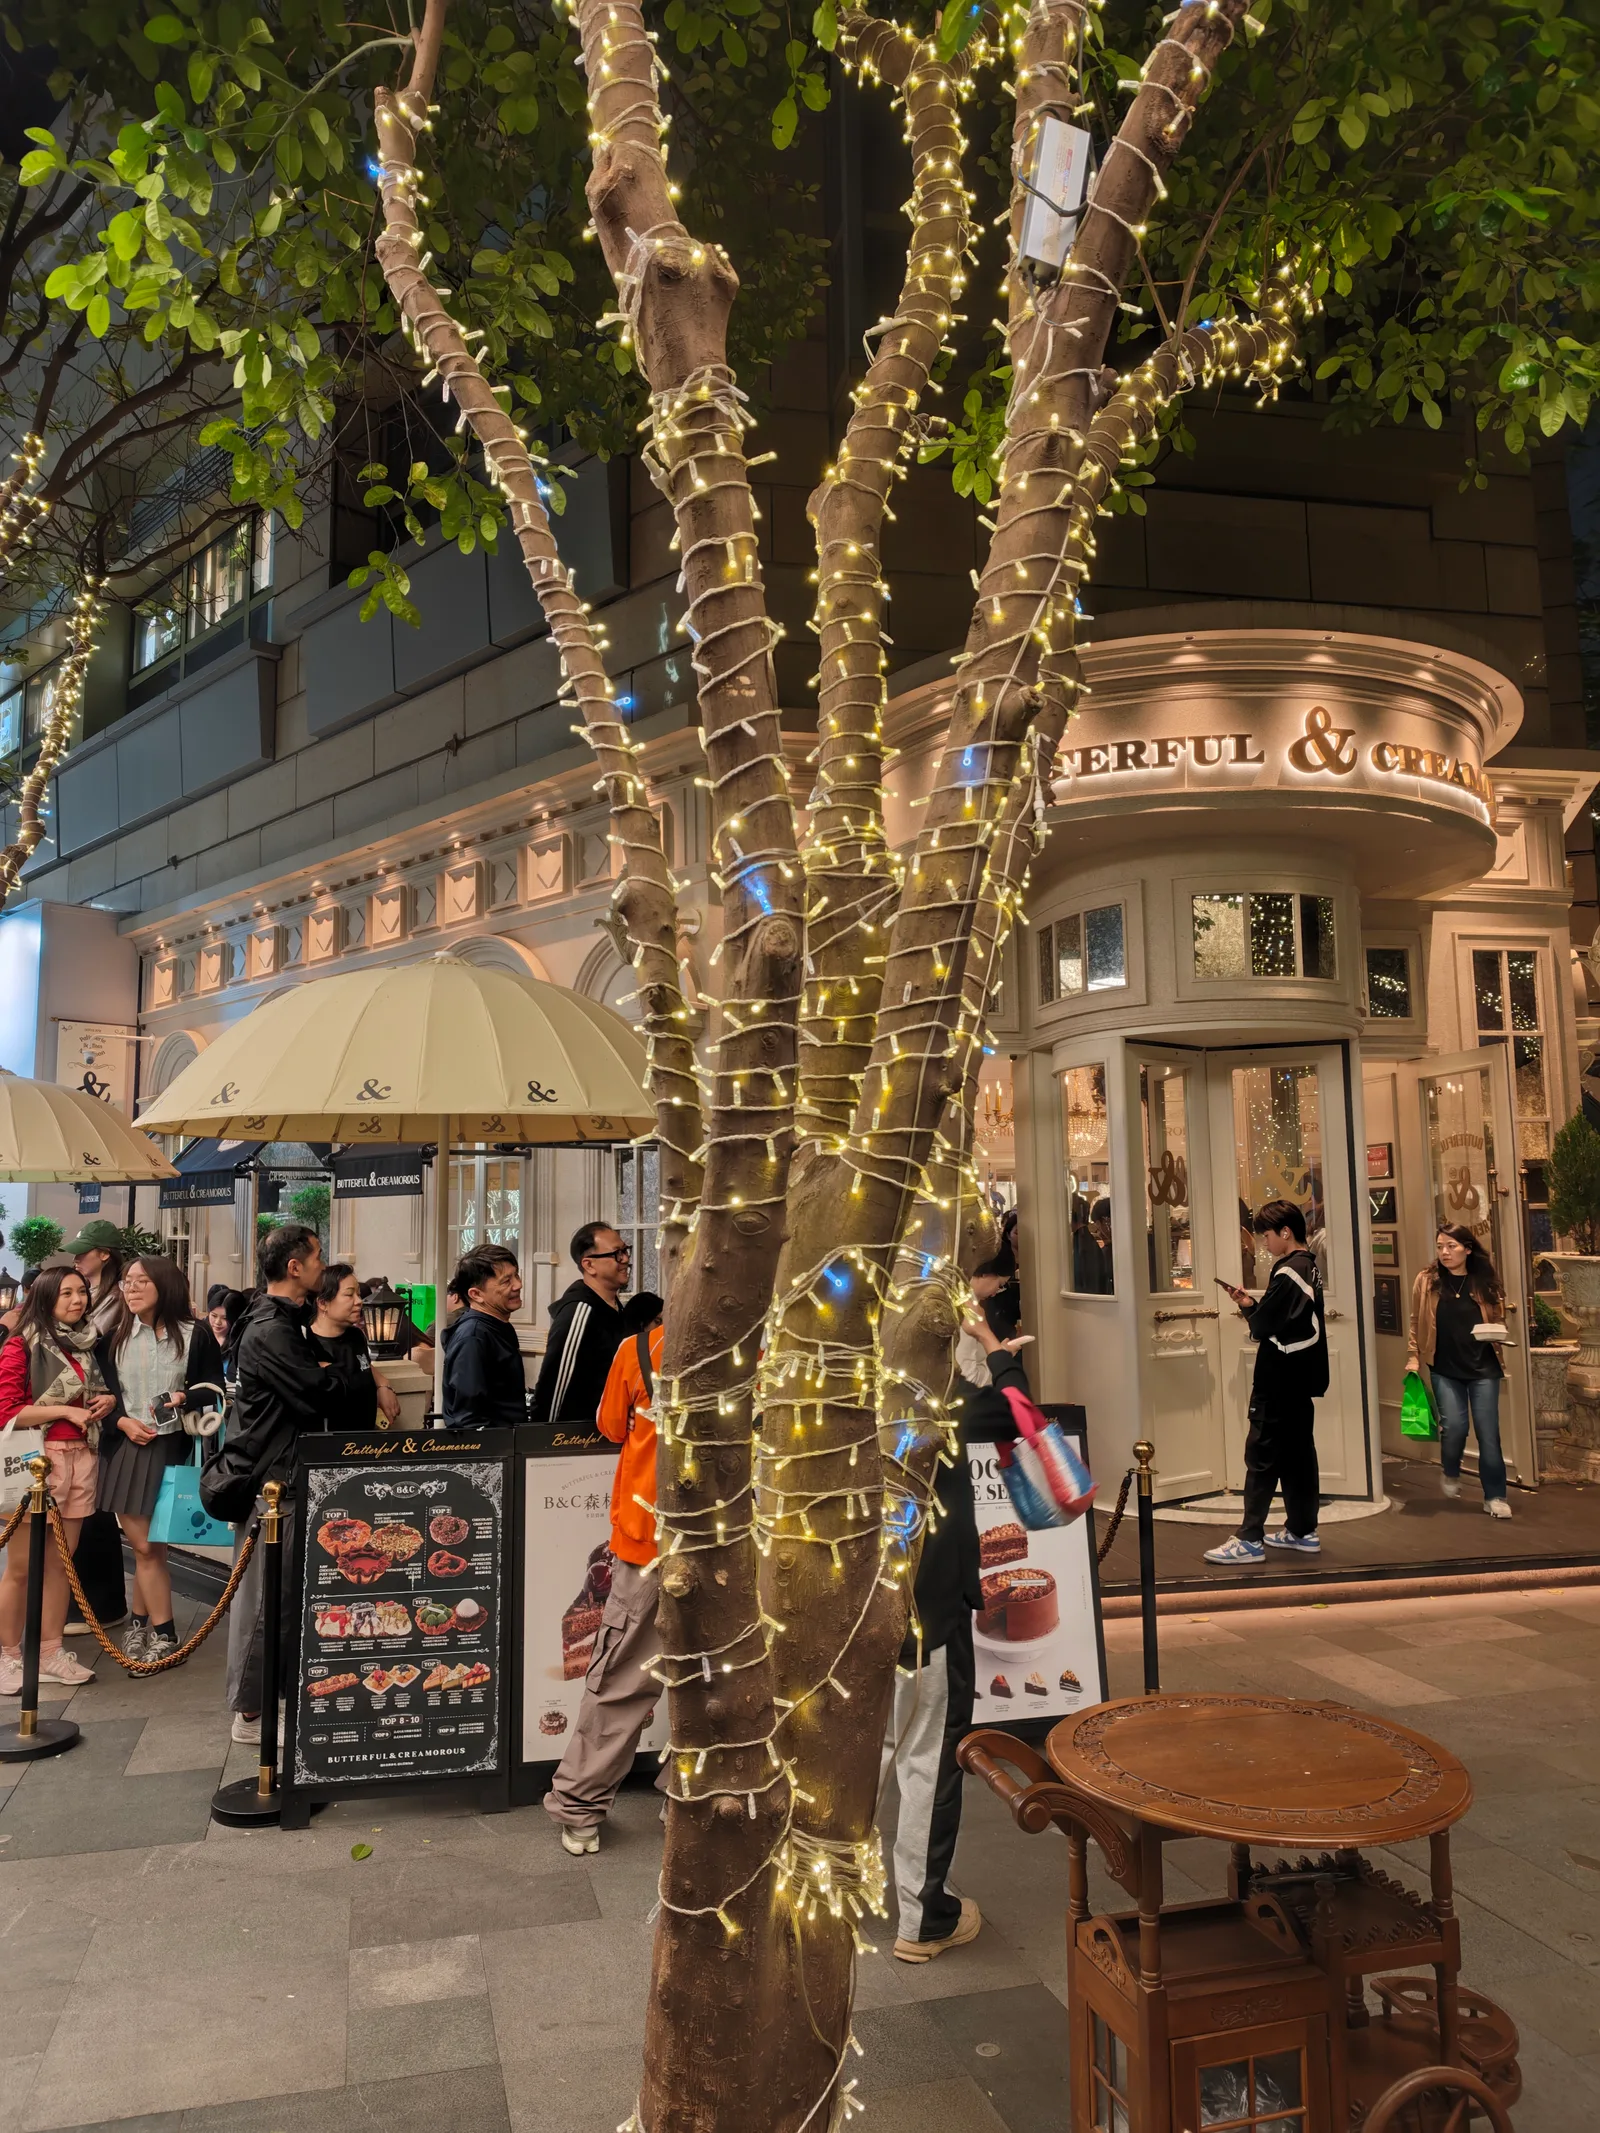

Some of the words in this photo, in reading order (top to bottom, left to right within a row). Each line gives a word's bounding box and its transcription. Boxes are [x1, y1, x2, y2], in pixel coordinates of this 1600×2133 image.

[1287, 705, 1358, 776] &
[337, 1179, 368, 1188] BUTTERFUL
[369, 1171, 376, 1187] &
[377, 1175, 420, 1186] CREAMOROUS
[196, 1187, 231, 1198] CREAMOROUS
[341, 1442, 399, 1458] Butterful
[402, 1438, 418, 1454] &
[421, 1439, 482, 1452] Creamorous
[4, 1456, 21, 1467] Be
[396, 1486, 416, 1495] B&C
